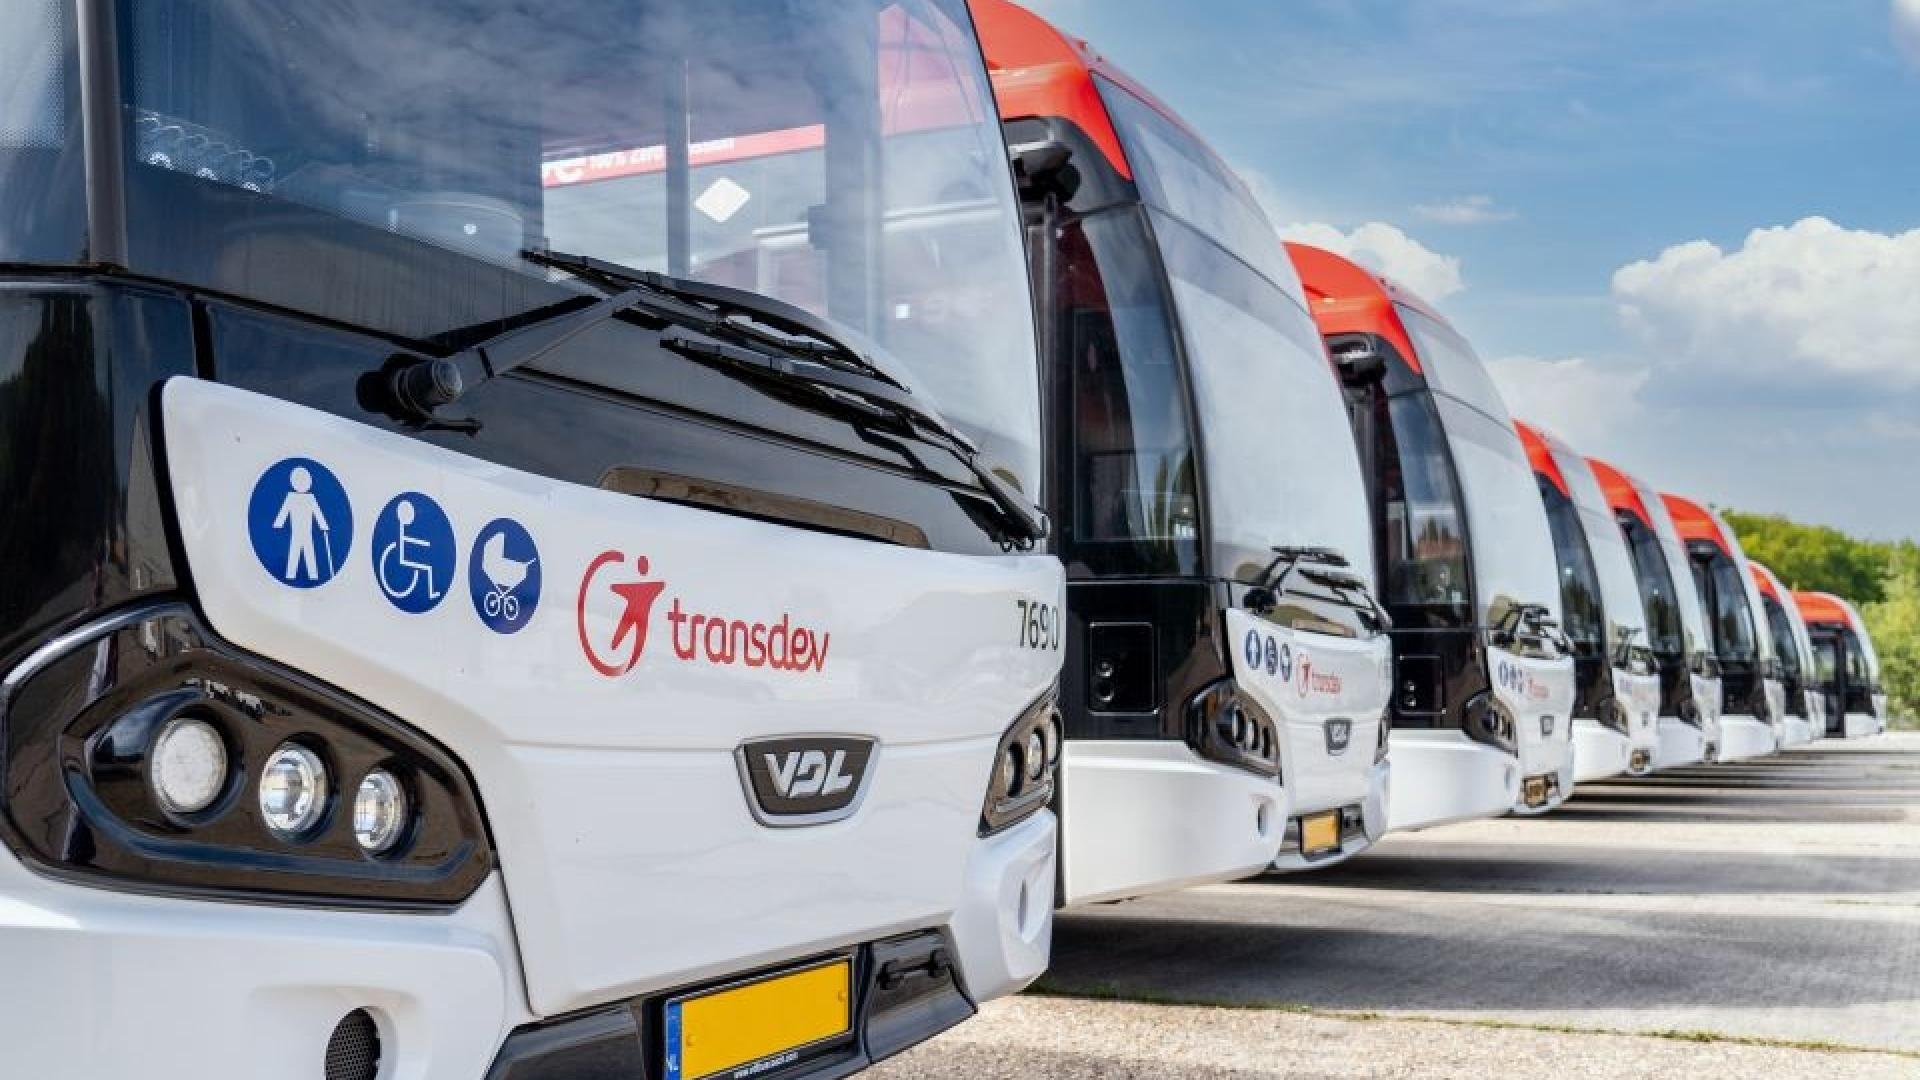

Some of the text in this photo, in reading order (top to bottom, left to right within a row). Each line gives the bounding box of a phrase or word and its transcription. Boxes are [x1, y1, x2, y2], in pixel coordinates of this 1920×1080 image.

[668, 598, 830, 672] transdev
[1017, 600, 1059, 651] 7690
[764, 750, 853, 798] VDL
